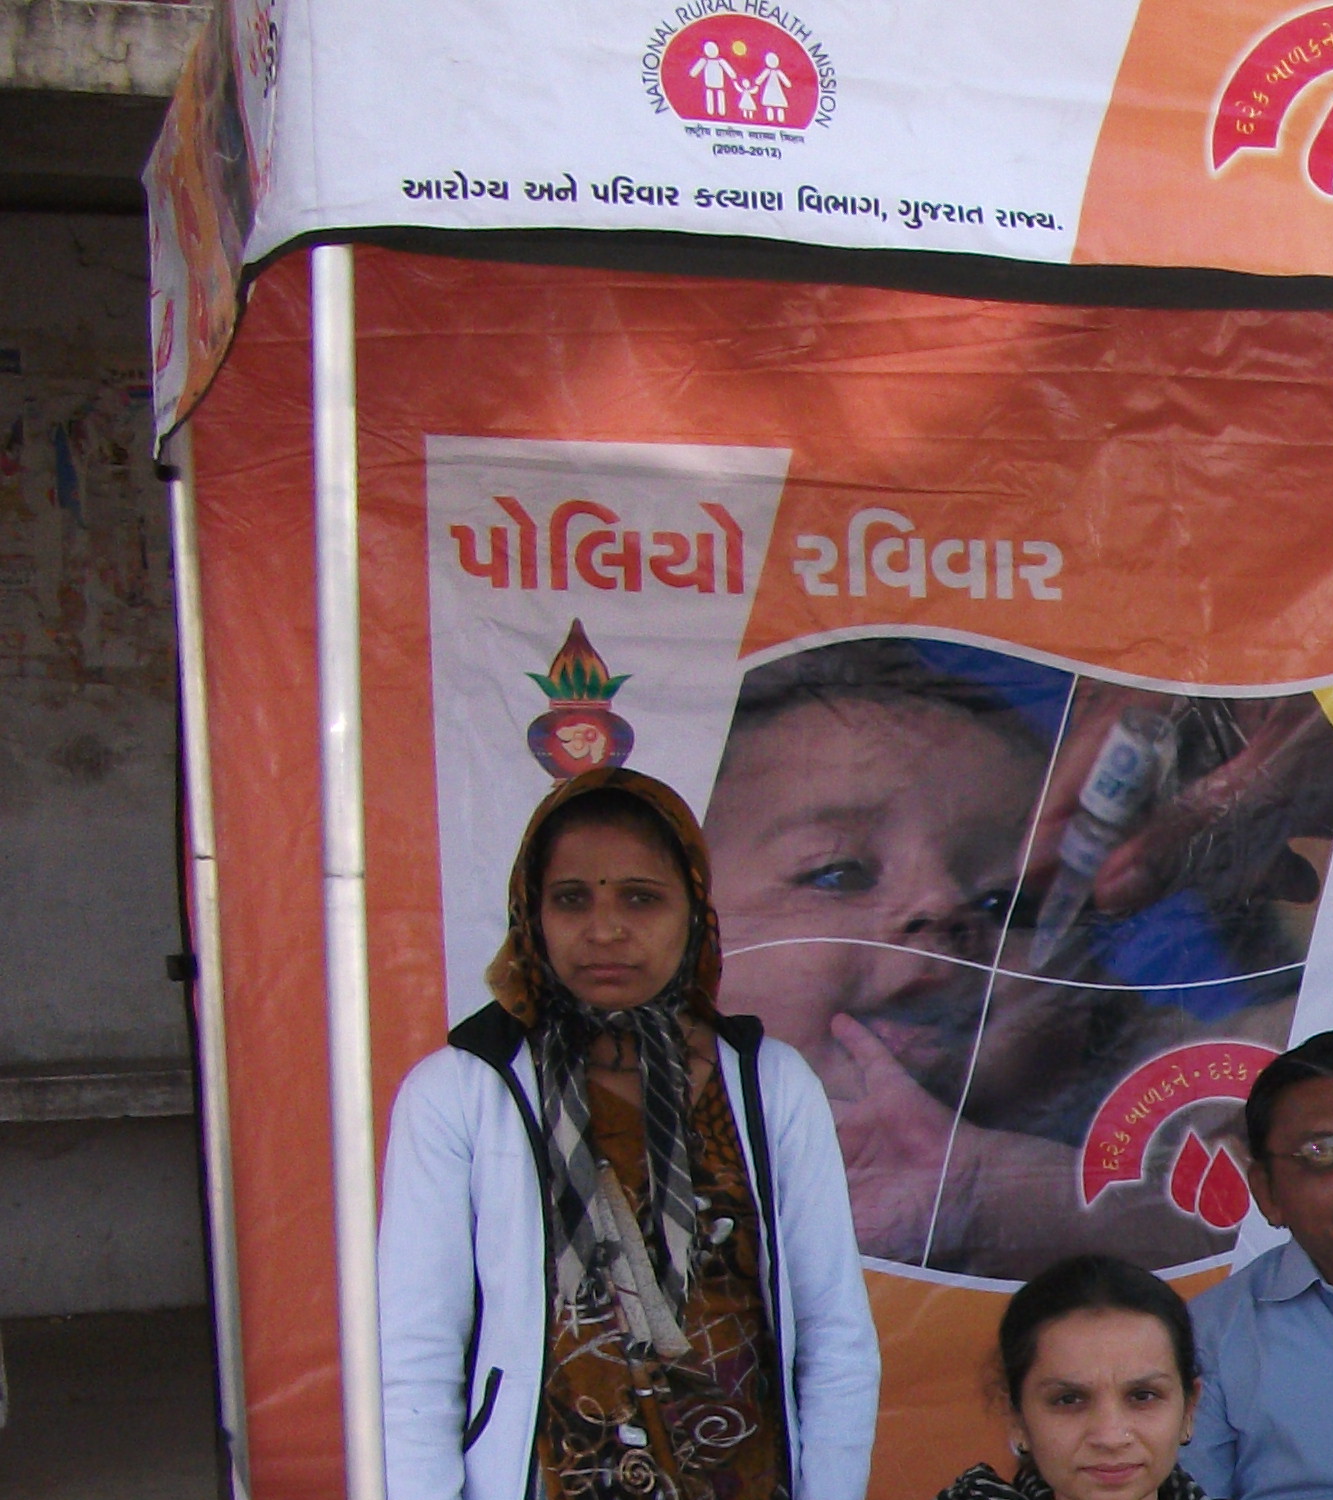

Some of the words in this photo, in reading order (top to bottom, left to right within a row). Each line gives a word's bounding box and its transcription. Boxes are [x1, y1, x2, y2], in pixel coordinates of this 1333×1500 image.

[642, 20, 678, 115] NATIONAL
[675, 0, 738, 25] RURAL
[744, 0, 813, 42] HEALTH
[808, 42, 837, 130] MISSION
[402, 170, 510, 202] આરોગ્ય
[524, 172, 578, 203] અને
[591, 175, 680, 207] પરિવાર
[694, 186, 783, 212] કલ્યાણ
[798, 185, 888, 222] વિભાગ,
[898, 198, 984, 230] ગુજરાત
[995, 206, 1064, 231] રાજ્ય.
[450, 496, 744, 594] પોલિયો
[793, 508, 1065, 601] રવિવાર
[1208, 1054, 1248, 1081] દરેક
